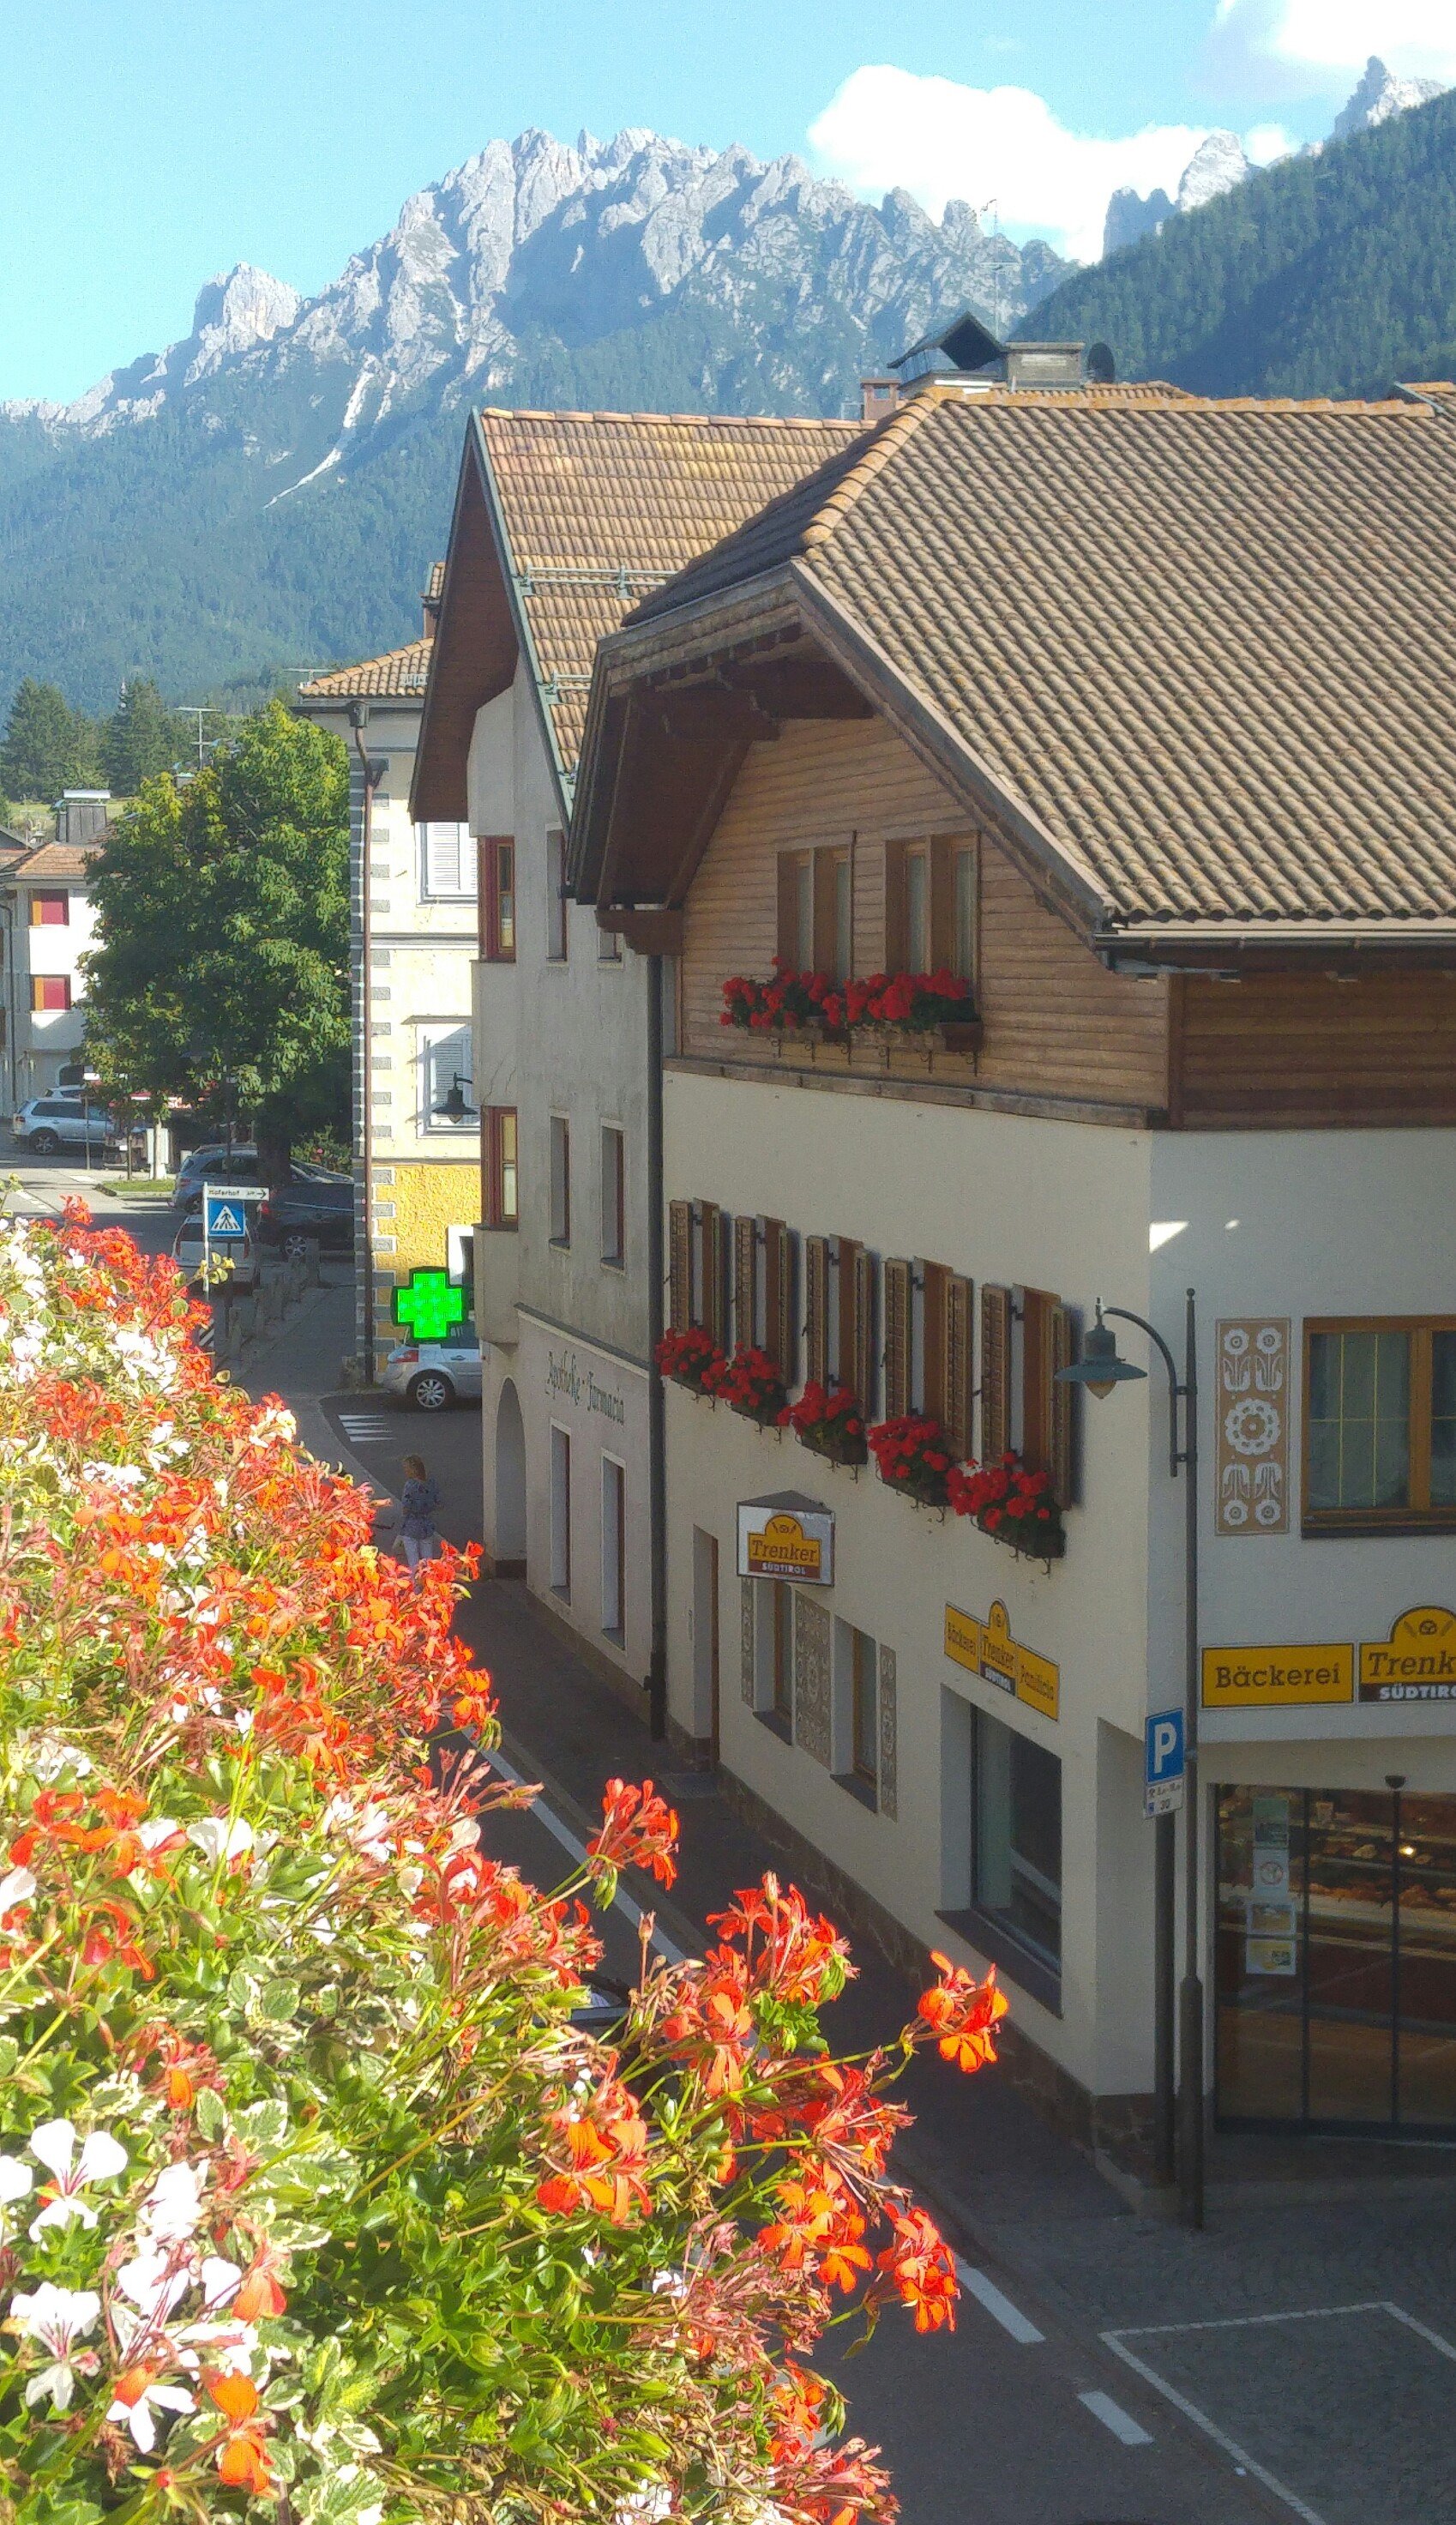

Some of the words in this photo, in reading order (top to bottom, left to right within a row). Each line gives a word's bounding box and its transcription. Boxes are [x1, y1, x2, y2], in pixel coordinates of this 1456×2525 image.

[752, 1540, 817, 1563] Trenker
[761, 1562, 806, 1576] SÜDTIROL
[980, 1633, 1014, 1670] Trenker
[1214, 1662, 1340, 1689] Bäckerei
[1154, 1721, 1177, 1774] P
